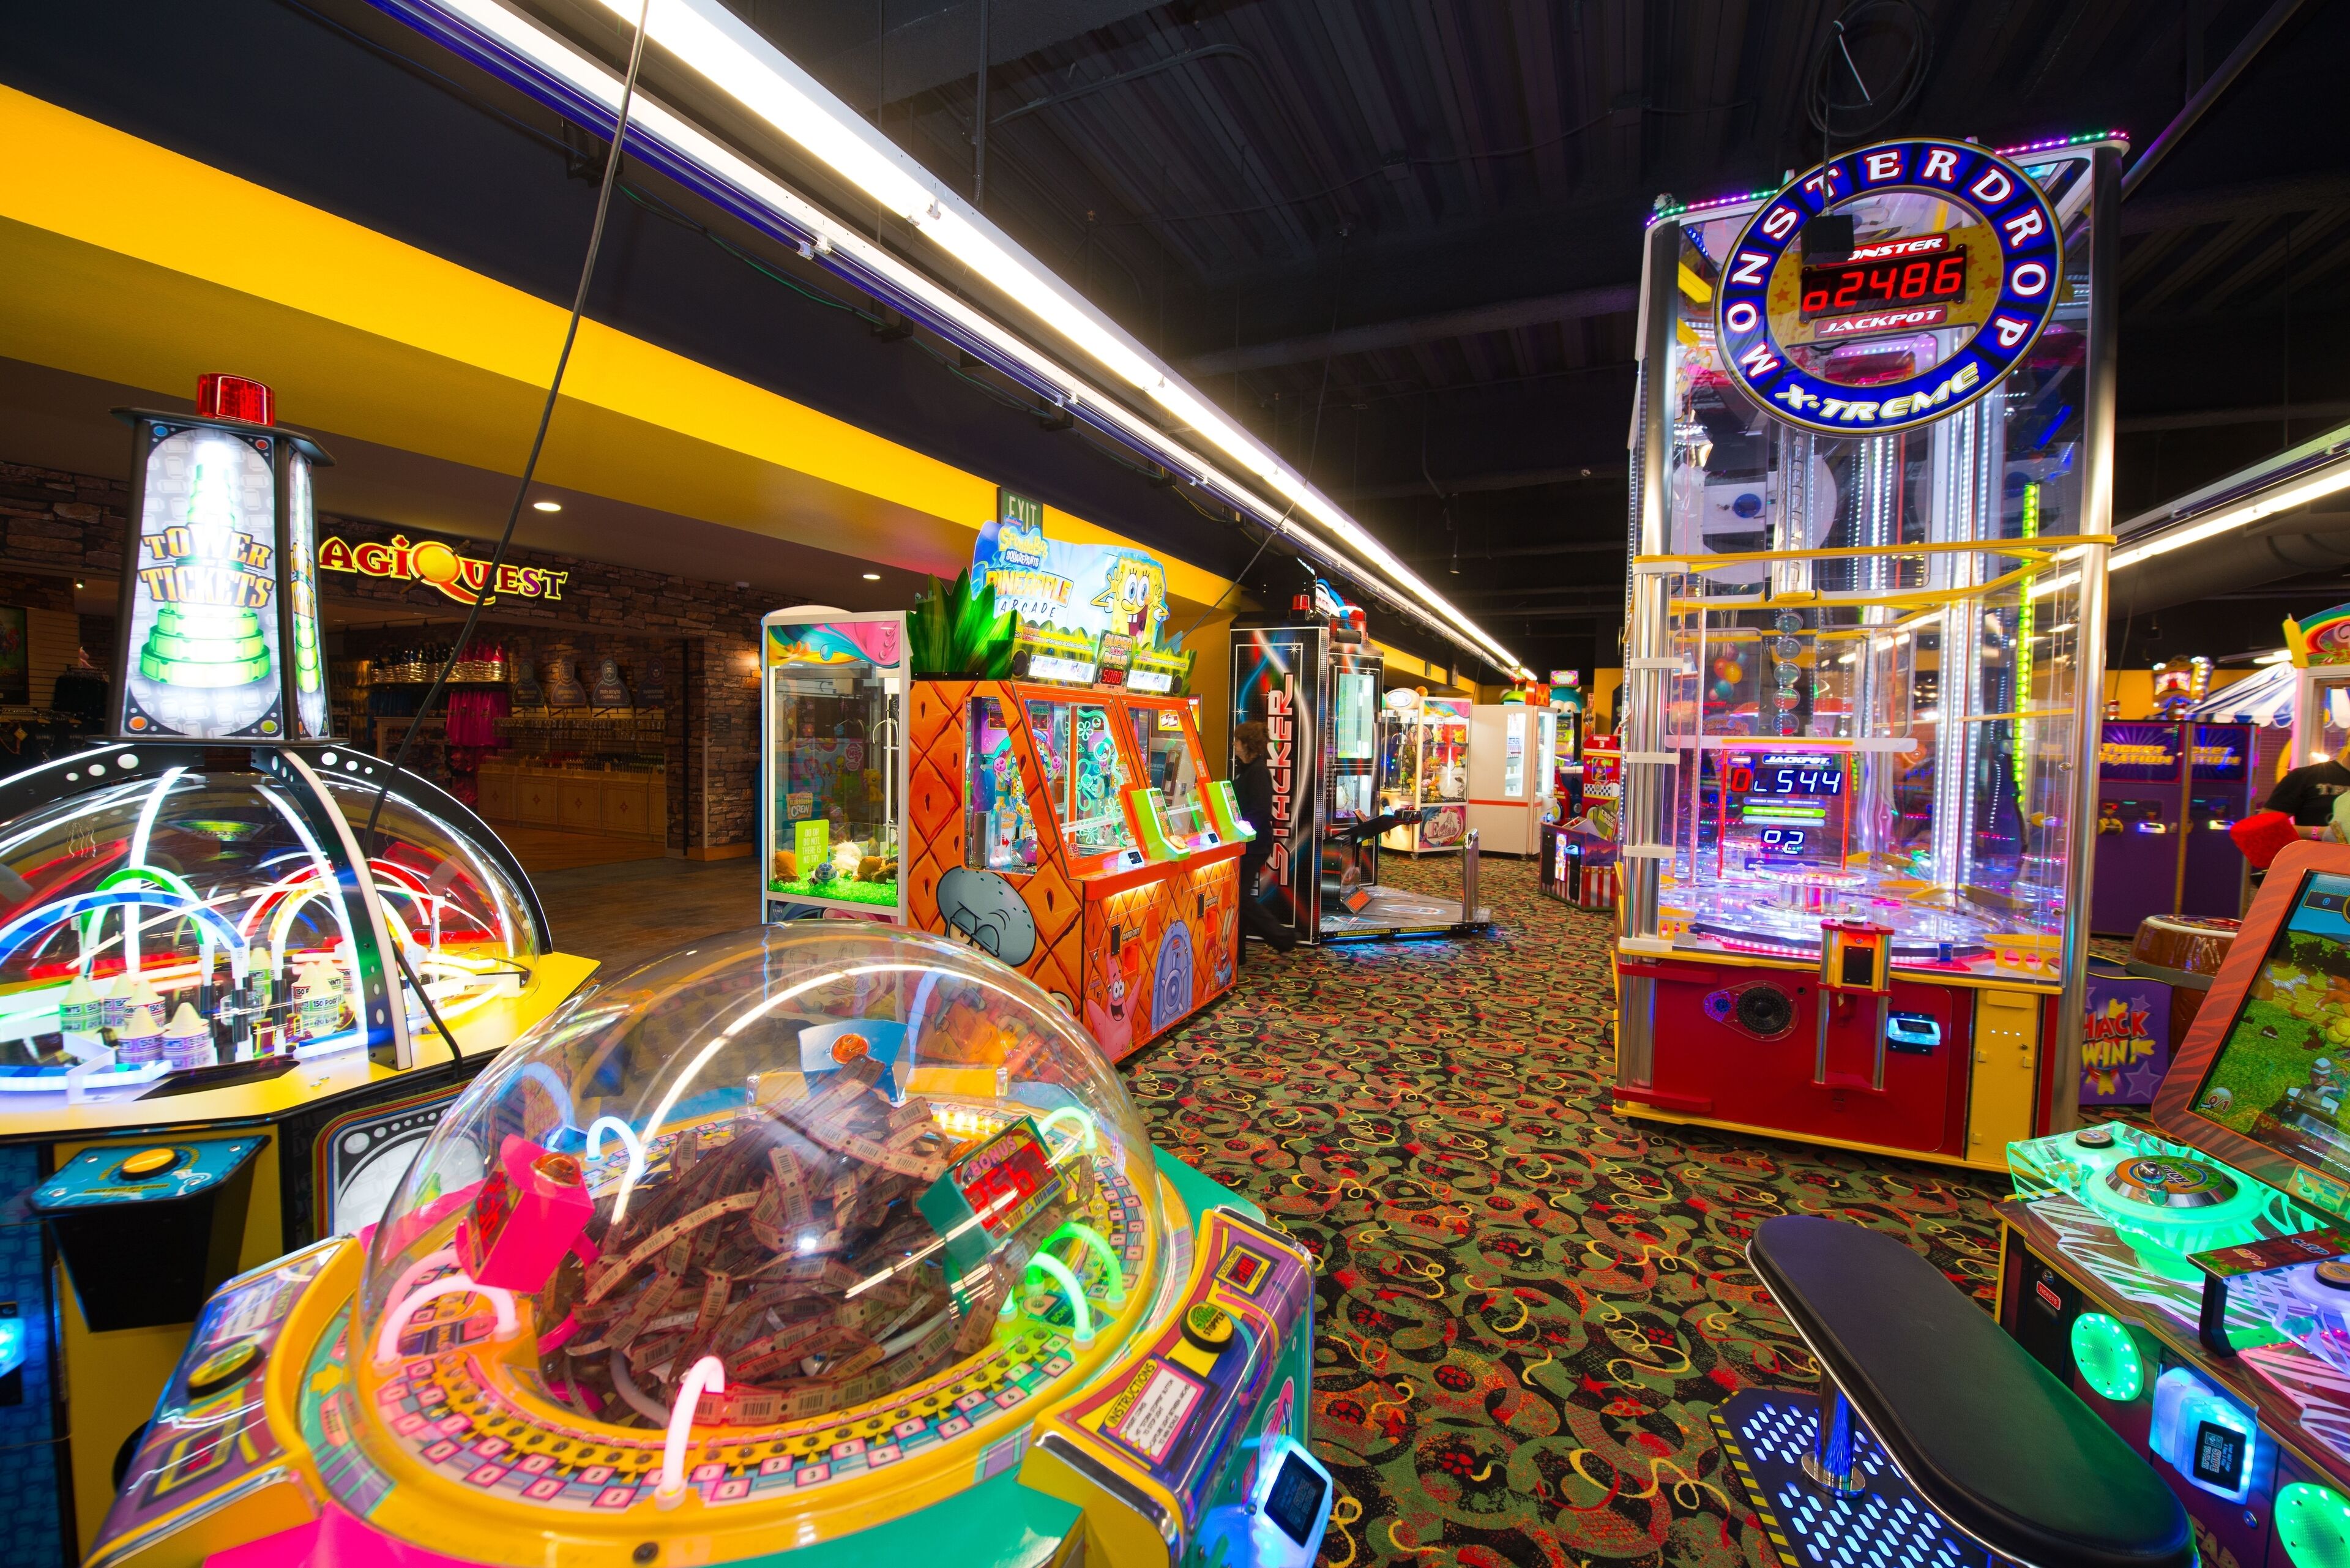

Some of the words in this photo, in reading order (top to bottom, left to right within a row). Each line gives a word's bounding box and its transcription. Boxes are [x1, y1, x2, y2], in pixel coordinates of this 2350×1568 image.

[1848, 236, 1945, 263] ONSTER
[1820, 308, 1942, 335] JACKPOT
[1775, 362, 1981, 422] X-TREME
[1009, 495, 1037, 533] EXIT
[141, 523, 273, 570] TOWER
[1006, 550, 1040, 567] SQUAREPANTS
[138, 566, 275, 608] TICKETS
[986, 570, 1072, 605] PINEAPPLE
[1001, 599, 1056, 618] ARCADE
[1103, 632, 1133, 651] SUPER
[1103, 651, 1128, 666] BONUS
[2100, 754, 2175, 766] STATION
[2102, 742, 2168, 755] TICKET
[2193, 745, 2234, 755] CKET
[1266, 672, 1294, 887] STACKER
[791, 804, 811, 818] CREW
[802, 846, 816, 855] THERE
[803, 838, 810, 846] DO
[2322, 897, 2330, 906] 0
[2083, 1011, 2150, 1039] HACK
[2082, 1040, 2137, 1068] WIN!
[969, 1135, 1017, 1178] BONUS
[2039, 1286, 2057, 1305] TICKETS
[1205, 1311, 1225, 1337] STOPPER
[1111, 1362, 1155, 1425] INSTRUCTIONS
[2209, 1448, 2222, 1473] SWIPE
